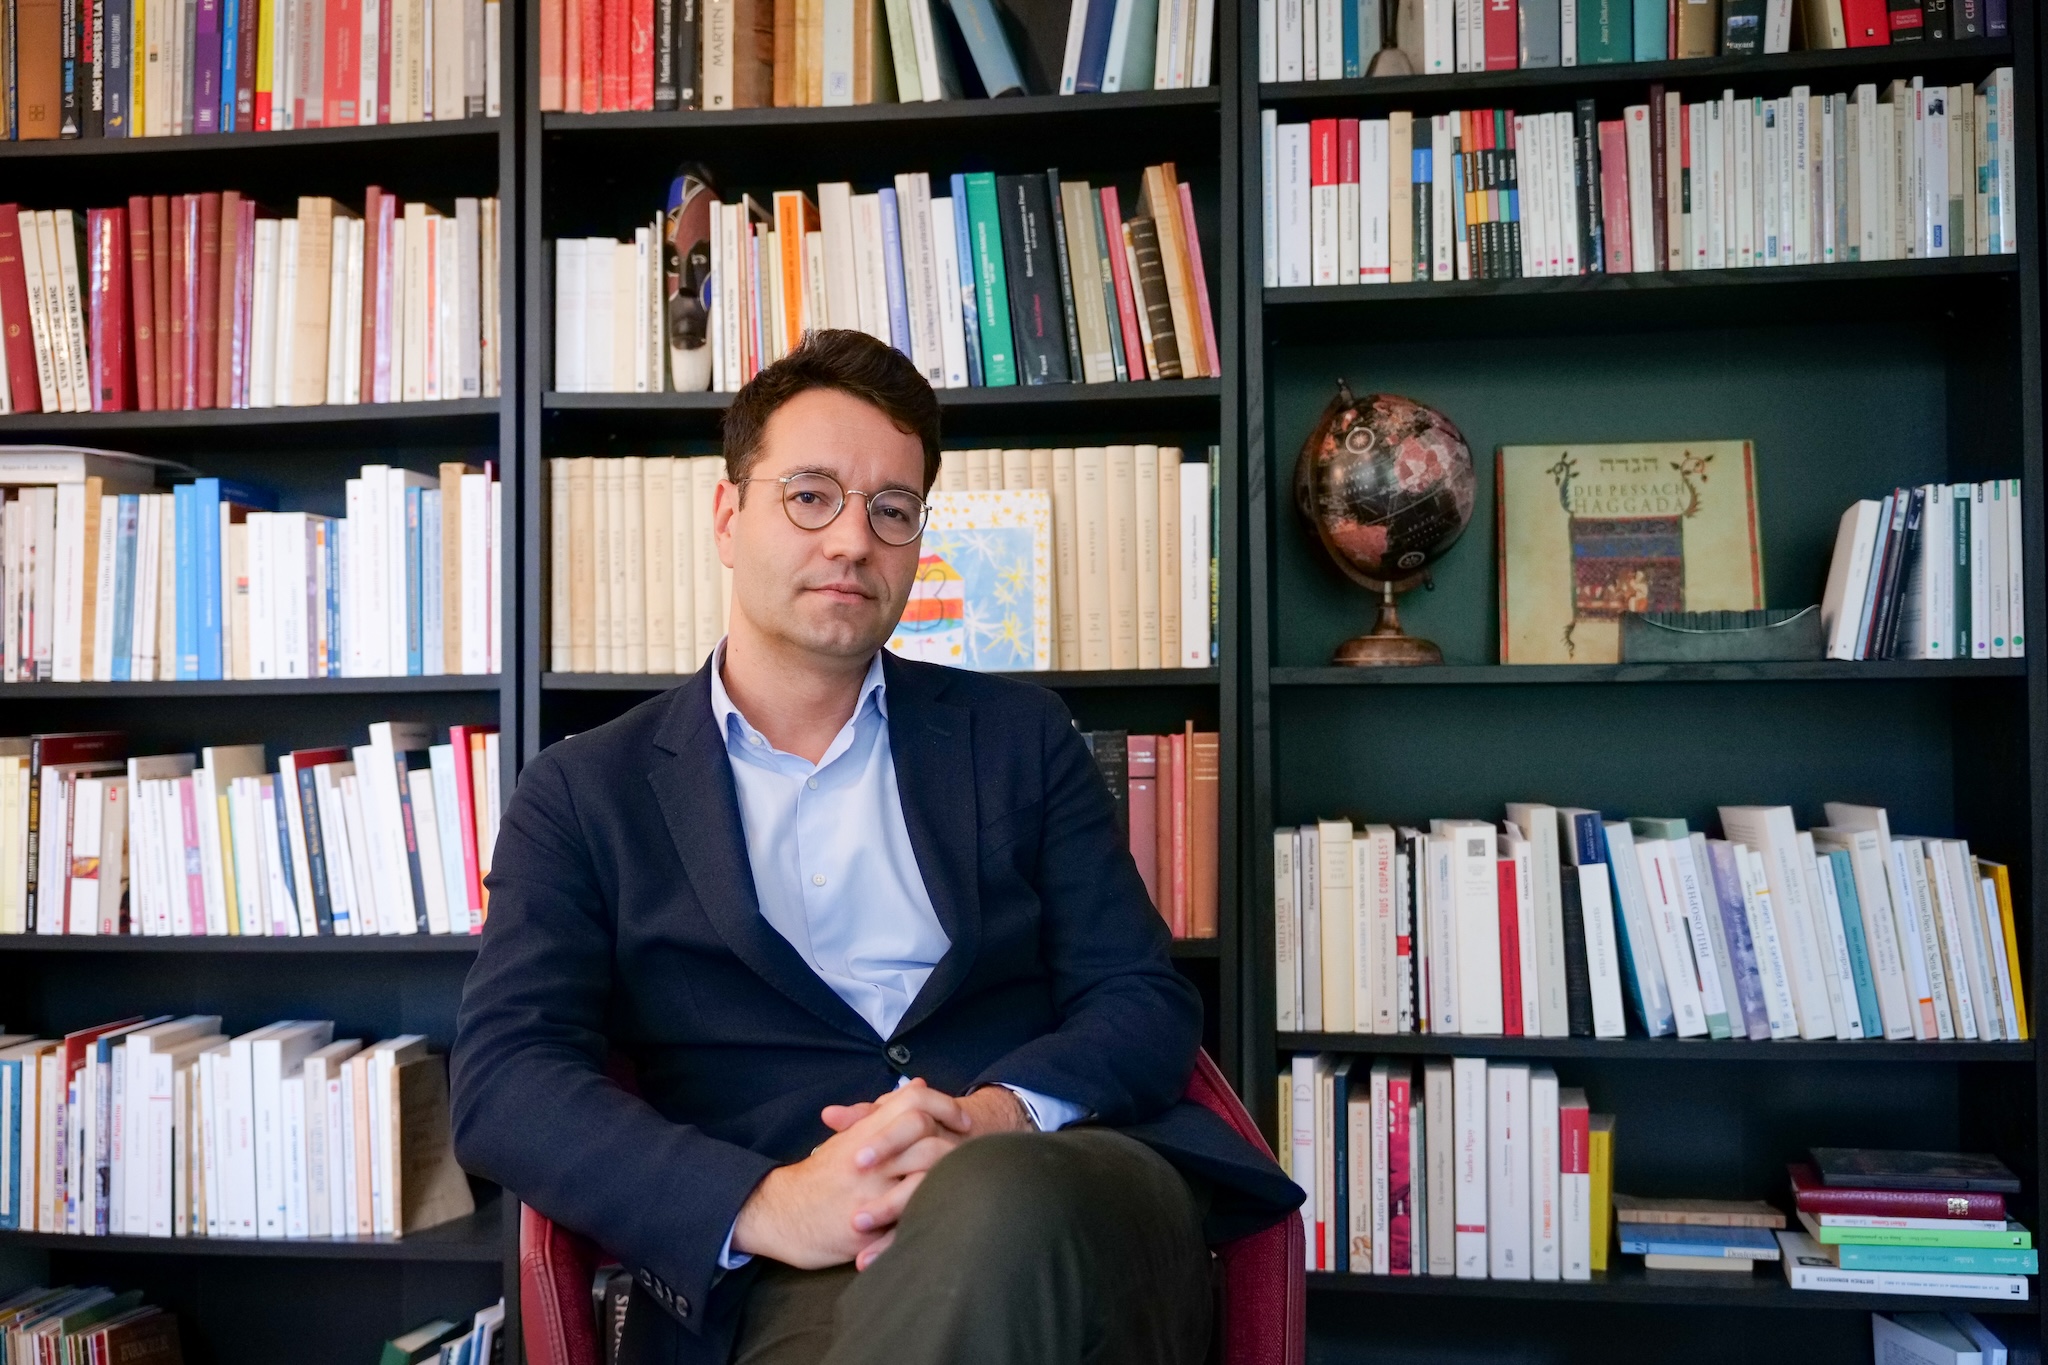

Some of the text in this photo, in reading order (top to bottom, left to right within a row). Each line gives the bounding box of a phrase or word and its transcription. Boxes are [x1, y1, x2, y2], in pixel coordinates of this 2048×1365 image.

[660, 6, 671, 83] Martin Luther und
[712, 7, 724, 67] MARTIN
[65, 60, 74, 107] LA BIBLE
[92, 18, 102, 111] NOMS PROPRES DE
[1017, 185, 1025, 204] France
[921, 252, 930, 264] des
[1102, 257, 1112, 283] CALVIN
[67, 284, 77, 313] MARC
[1574, 482, 1686, 497] DIE PESSACH
[1574, 496, 1684, 514] HAGGADA
[1378, 846, 1388, 894] COUPABLES
[1379, 897, 1389, 918] TOUS
[1683, 874, 1710, 958] PHILOSOPHEN
[1838, 947, 1850, 980] Récidive
[1375, 1089, 1385, 1231] Martin Graff Comme l'Allemagne
[1465, 1129, 1475, 1183] Charles Péguy
